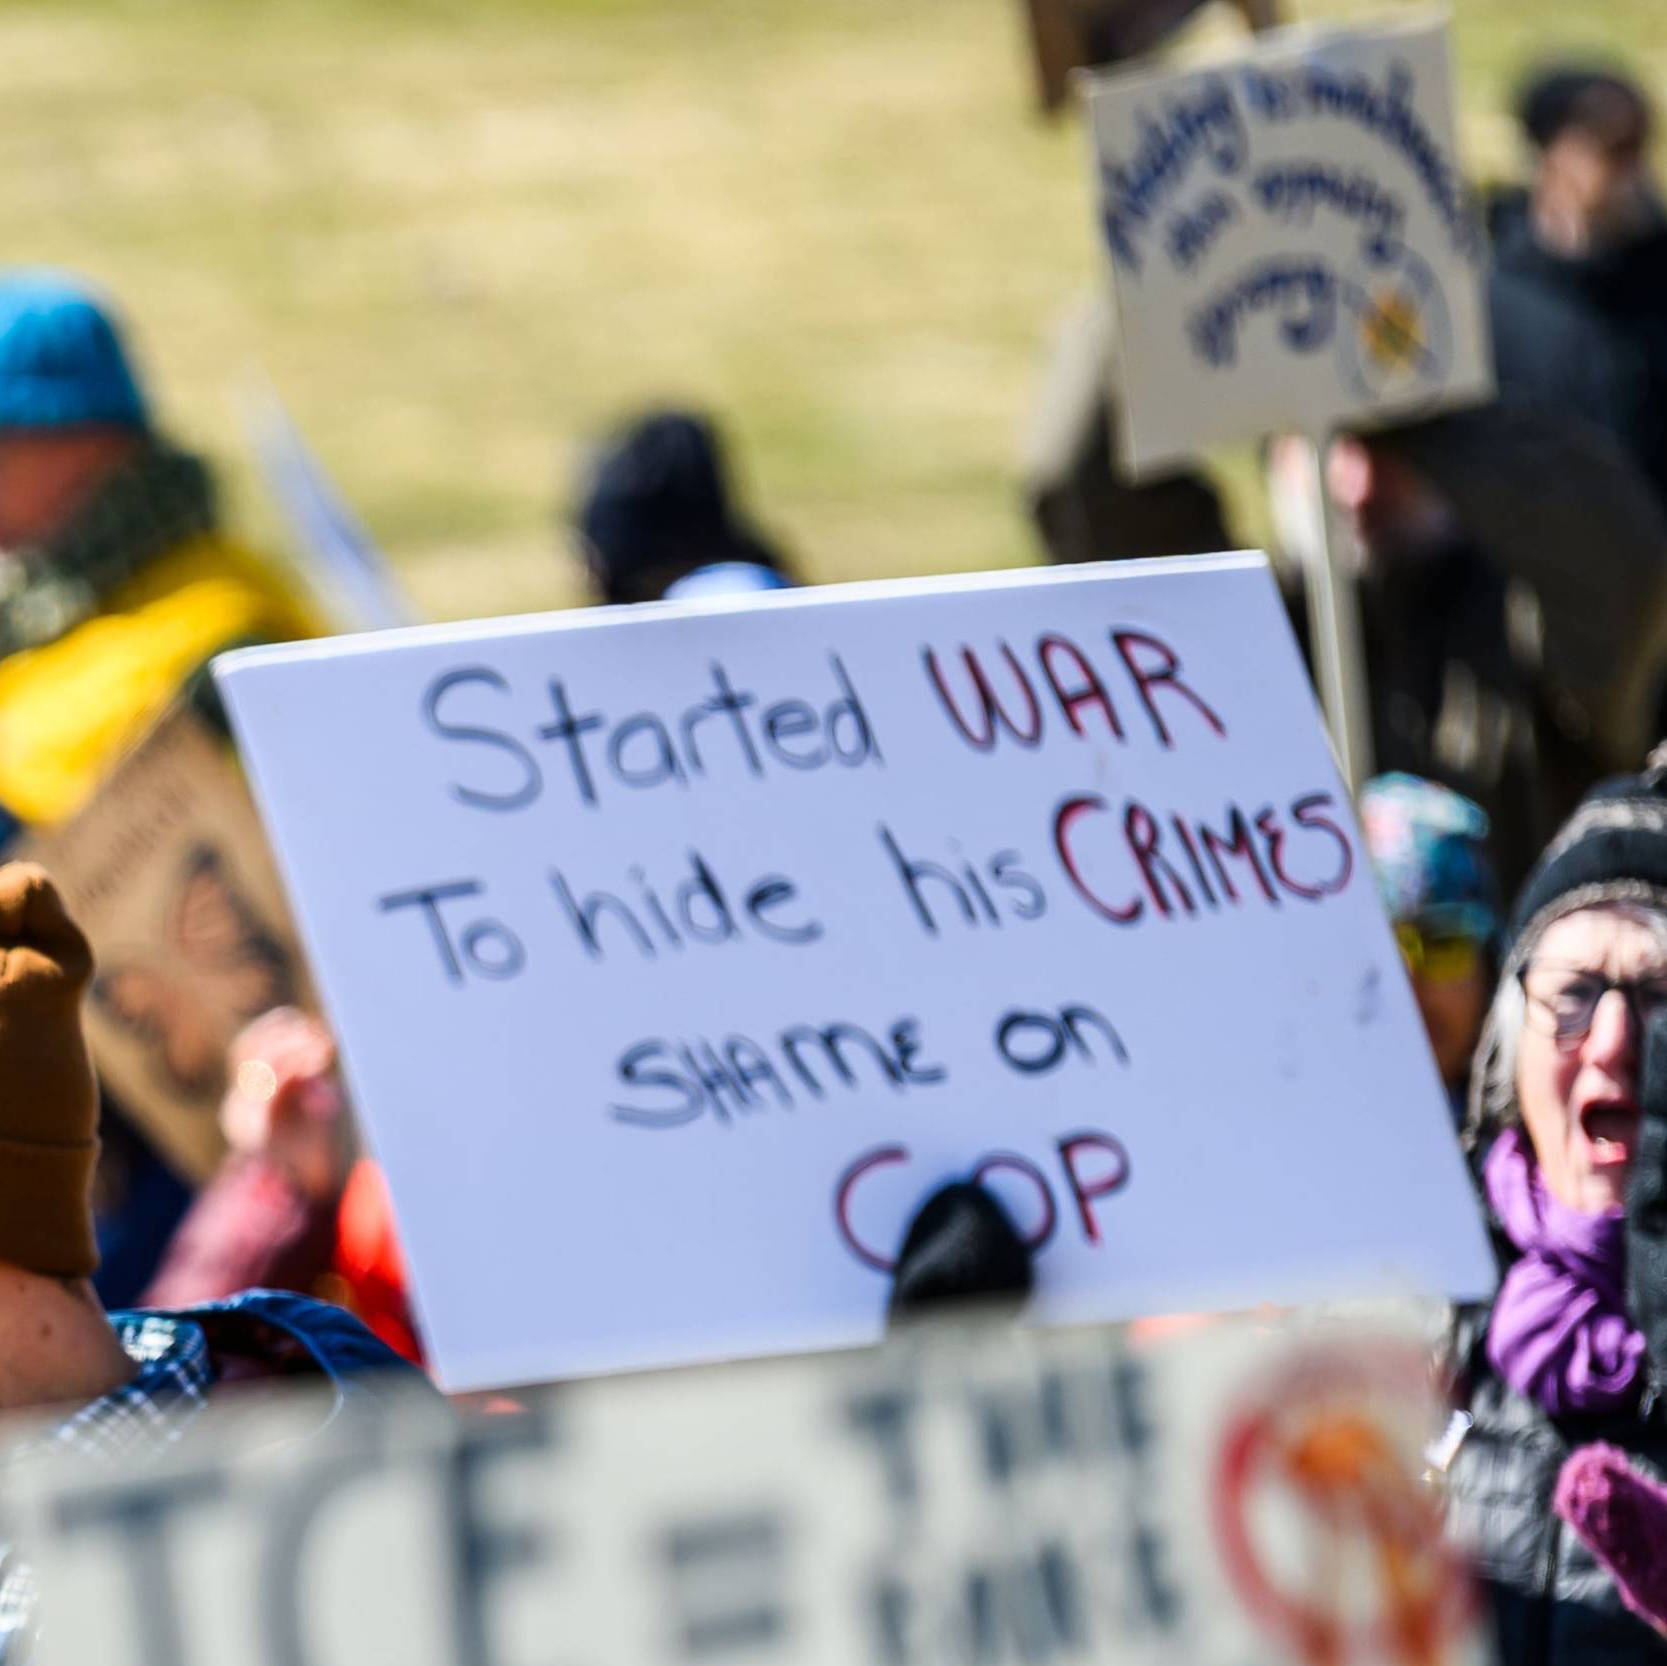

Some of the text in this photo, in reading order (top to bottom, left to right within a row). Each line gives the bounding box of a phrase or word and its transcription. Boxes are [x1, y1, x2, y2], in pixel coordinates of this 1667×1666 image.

[420, 625, 1227, 813] Started WAR
[377, 792, 1357, 988] To hide his CRIMES
